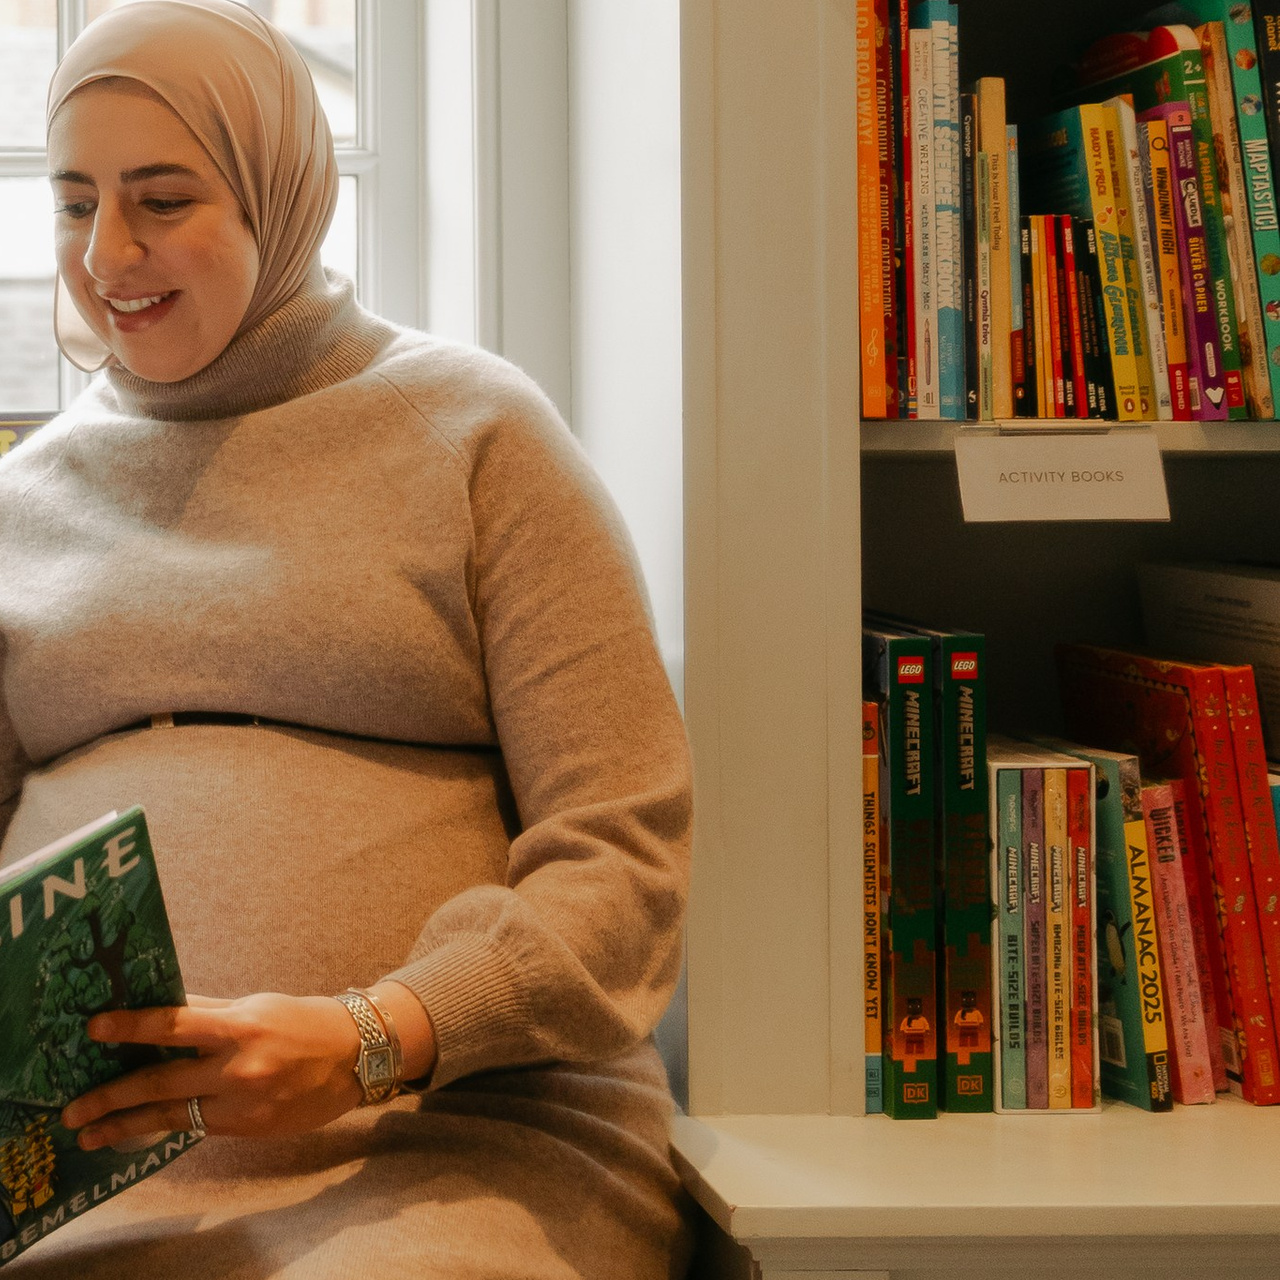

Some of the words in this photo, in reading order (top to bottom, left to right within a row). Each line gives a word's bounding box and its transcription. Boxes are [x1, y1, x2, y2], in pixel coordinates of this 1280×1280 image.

[1264, 15, 1278, 51] planet
[932, 21, 951, 121] MAMMOTH
[1184, 60, 1202, 75] 2+
[857, 38, 873, 145] BROADWAY!
[876, 79, 887, 161] COMPENDIUM
[918, 89, 929, 140] CREATIVE
[964, 115, 972, 157] Cyanotype
[1090, 127, 1101, 160] HAIDT
[920, 144, 930, 195] WRITING
[935, 125, 953, 204] SCIENCE
[992, 154, 1000, 170] This
[1133, 165, 1141, 186] Pizza
[1095, 169, 1107, 197] PRICE
[1156, 167, 1173, 227] WHODUNNIT
[1244, 138, 1278, 231] MAPTASTIC!
[922, 233, 930, 257] Miss
[992, 225, 1001, 251] Today
[1161, 228, 1175, 255] HIGH
[1189, 237, 1202, 271] SILVER
[1198, 142, 1216, 206] ALPHABET
[1215, 279, 1233, 352] WORKBOOK
[921, 262, 930, 287] Mary
[936, 210, 955, 310] WORKBOOK
[922, 291, 930, 310] Mac
[981, 290, 990, 322] Cynthia
[982, 323, 990, 345] Erivo
[1104, 285, 1129, 356] GENERATION
[1175, 377, 1183, 390] RED
[1177, 391, 1185, 410] SHED
[998, 471, 1065, 484] ACTIVITY
[1071, 470, 1125, 483] BOOKS
[899, 664, 923, 677] LEGO
[952, 660, 977, 673] LEGO
[903, 689, 922, 796] MINECRAFT
[956, 685, 975, 791] MINECRAFT
[864, 791, 875, 837] THINGS
[1149, 807, 1176, 864] WICKED
[865, 842, 876, 907] SCIENTISTS
[1007, 846, 1019, 915] MINECRAFT
[1029, 842, 1041, 904] MINECRAFT
[1051, 845, 1064, 913] MINECRAFT
[1077, 846, 1088, 908] MINECRAFT
[1129, 845, 1156, 967] ALMANAC
[866, 912, 877, 948] DON'T
[1031, 921, 1041, 953] SUPER
[1053, 924, 1064, 969] AMAZING
[1077, 925, 1087, 953] MEGA
[867, 952, 877, 992] KNOW
[1007, 934, 1021, 999] BITE-SIZE
[1031, 955, 1042, 1005] BITE-SIZE
[1077, 956, 1088, 1006] BITE-SIZE
[867, 996, 878, 1020] YET
[1053, 972, 1064, 1022] BITE-SIZE
[1141, 970, 1162, 1024] 2025
[1008, 1004, 1021, 1049] BUILDS
[1032, 1009, 1043, 1044] BUILDS
[1054, 1025, 1065, 1060] BUILDS
[1078, 1010, 1088, 1046] BUILDS
[906, 1084, 928, 1100] DK
[959, 1076, 981, 1092] DK
[1150, 1081, 1159, 1099] KIDS
[1155, 1065, 1166, 1102] GEOGRAPHIC
